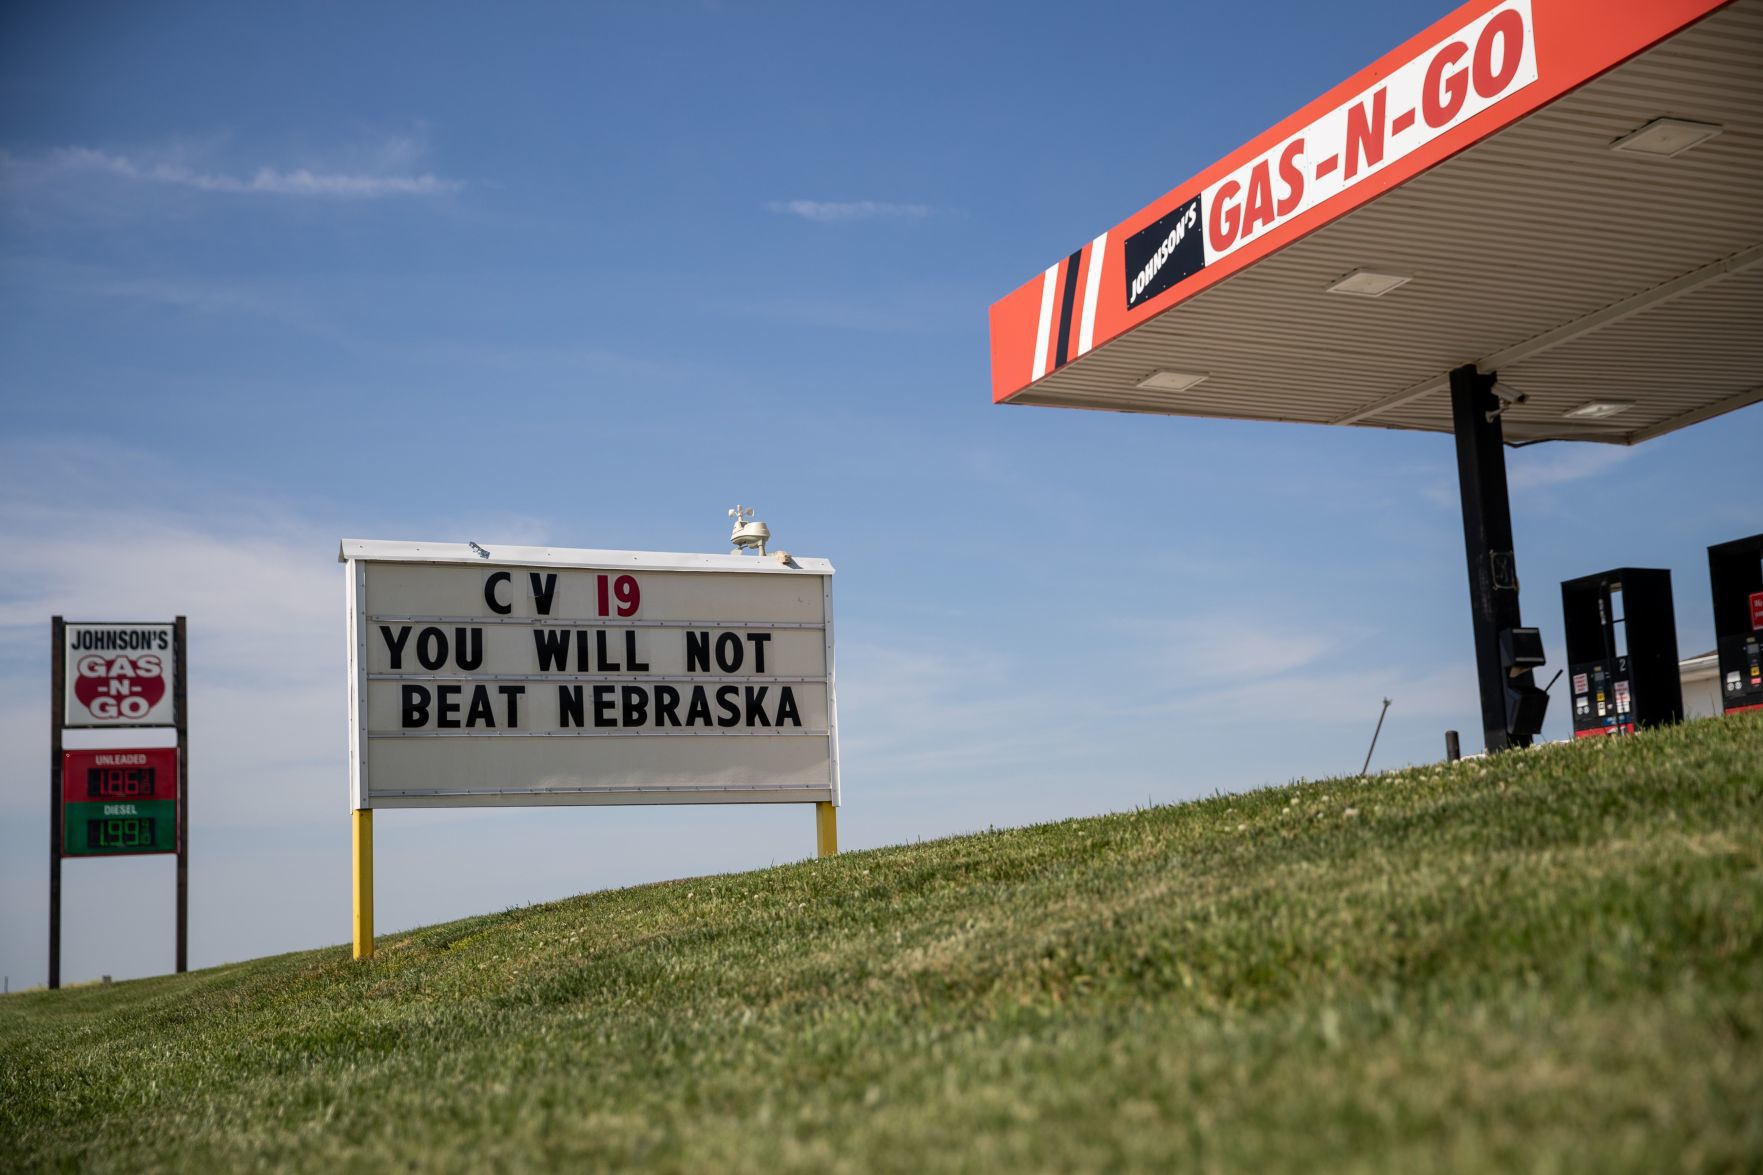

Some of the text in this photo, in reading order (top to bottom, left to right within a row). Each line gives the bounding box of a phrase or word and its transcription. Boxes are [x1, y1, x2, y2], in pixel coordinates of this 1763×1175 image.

[1208, 8, 1525, 253] GAS-N-GO
[1130, 201, 1198, 303] JOHNSON'S
[596, 574, 641, 617] 19
[71, 629, 169, 651] JOHNSON'S
[378, 625, 772, 673] YOU WILL NOT
[78, 655, 163, 679] GAS
[89, 697, 150, 718] GO
[401, 684, 802, 728] BEAT NEBRASKA
[95, 754, 147, 766] UNLEADED
[103, 804, 138, 815] DIESEL
